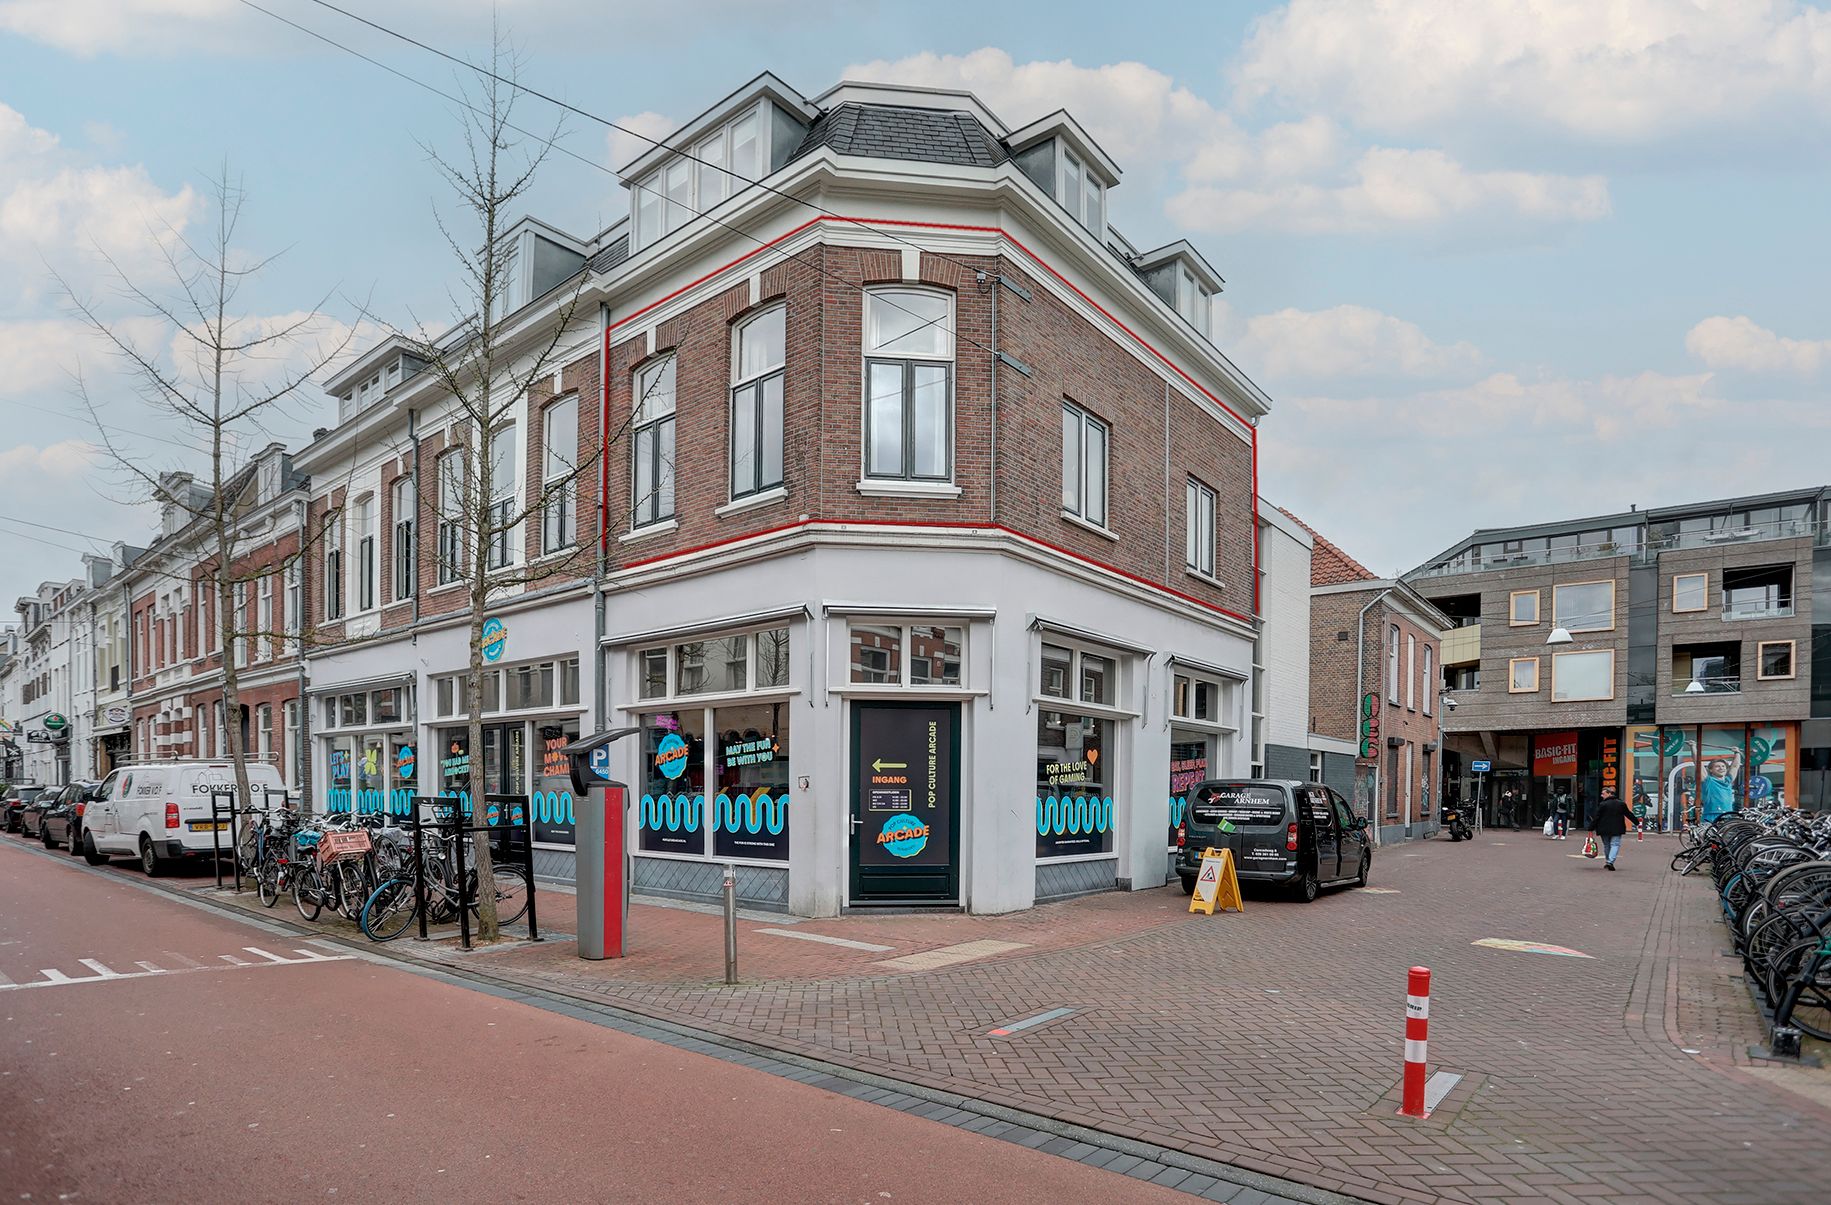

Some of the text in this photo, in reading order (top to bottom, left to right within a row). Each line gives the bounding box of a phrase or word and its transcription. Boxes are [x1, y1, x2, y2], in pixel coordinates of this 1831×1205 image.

[545, 737, 568, 751] YOUR
[725, 744, 741, 756] MAY
[742, 742, 756, 753] THE
[1535, 743, 1577, 759] BASIC-FIT
[592, 748, 607, 766] P
[655, 744, 689, 766] ARCADE
[727, 751, 773, 767] BE WITH YOU
[1552, 755, 1576, 765] INGANG
[928, 721, 937, 809] POP CULTURE ARCADE
[1046, 761, 1087, 775] FOR THE LOVE
[872, 776, 907, 784] INGANG
[1049, 772, 1085, 785] OF GAMING
[876, 825, 930, 844] ARCADE
